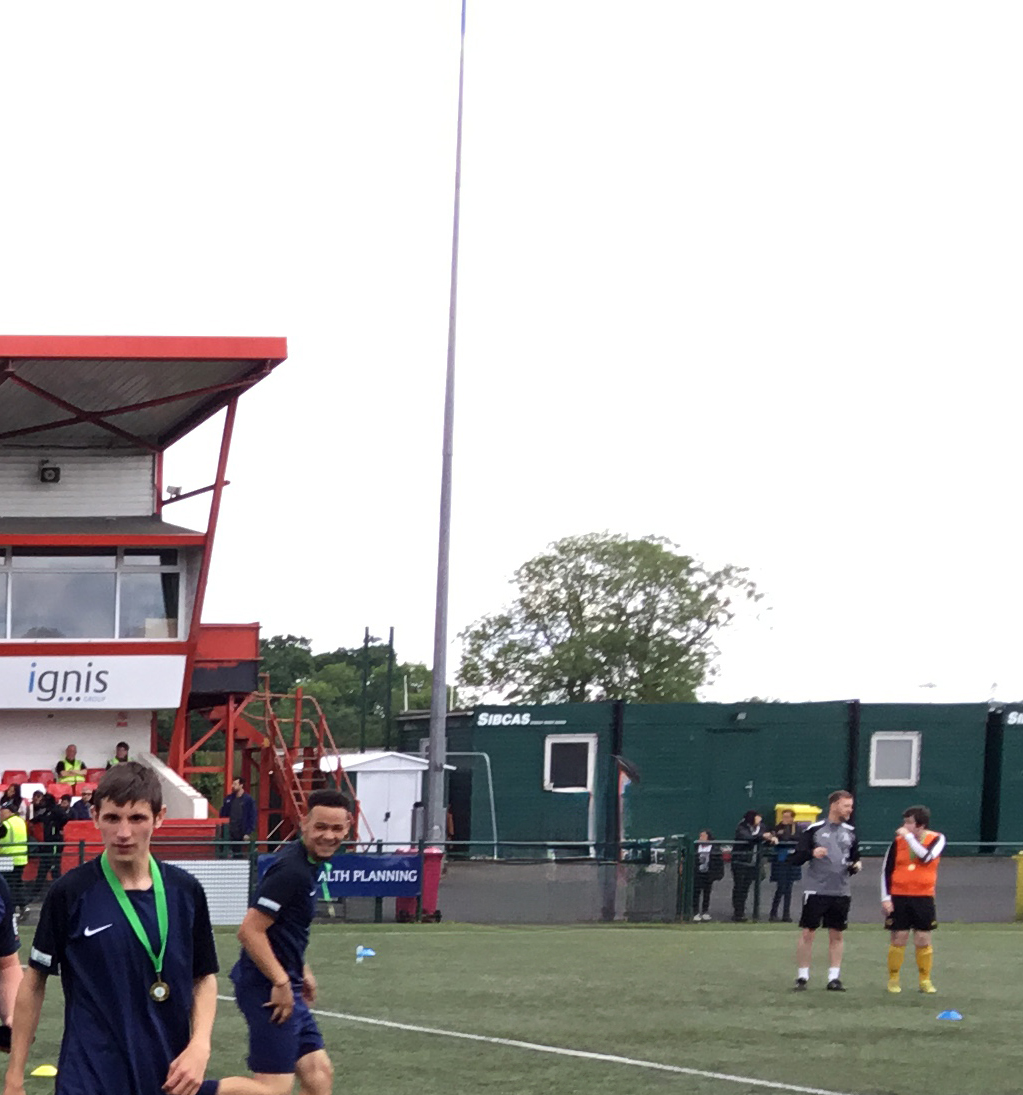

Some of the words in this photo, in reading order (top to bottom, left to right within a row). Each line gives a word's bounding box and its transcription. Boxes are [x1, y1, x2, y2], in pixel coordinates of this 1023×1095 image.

[28, 662, 109, 702] ignis
[477, 712, 531, 726] SIBCAS
[317, 870, 350, 882] ALTH
[353, 869, 418, 882] PLANNING
